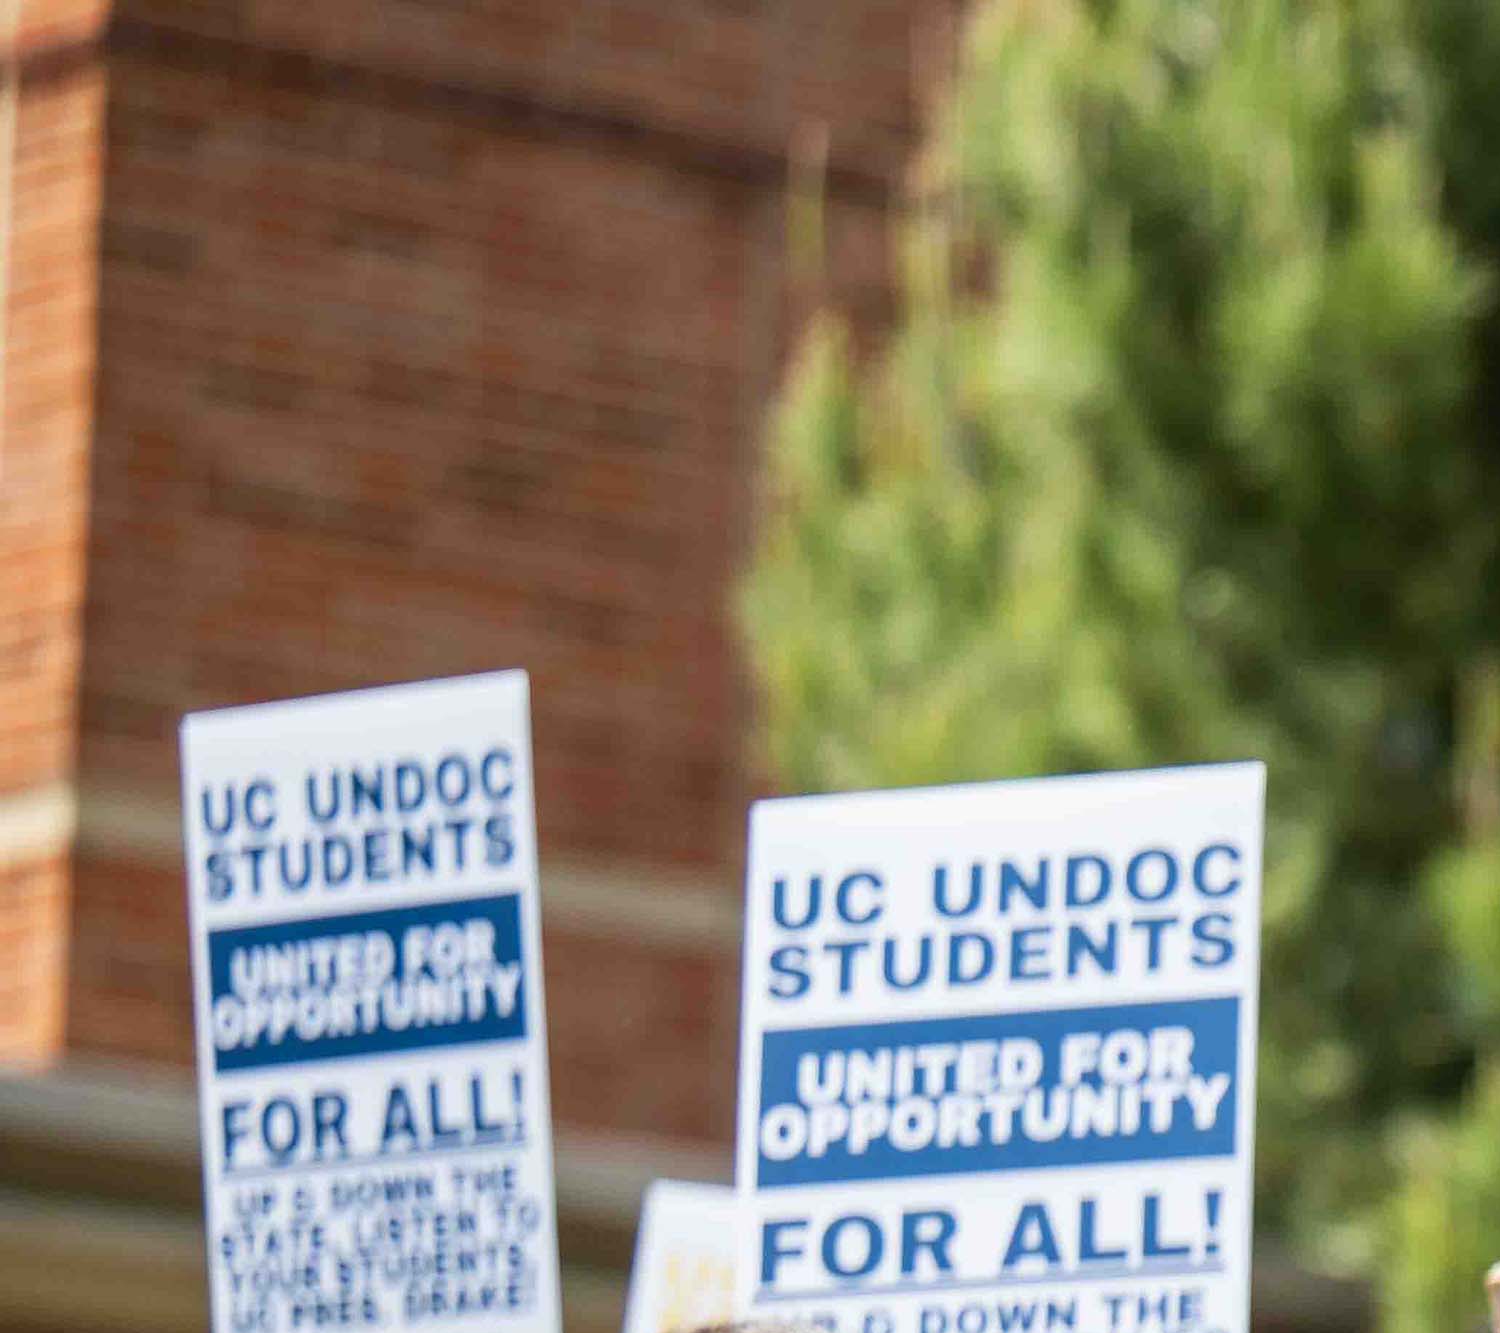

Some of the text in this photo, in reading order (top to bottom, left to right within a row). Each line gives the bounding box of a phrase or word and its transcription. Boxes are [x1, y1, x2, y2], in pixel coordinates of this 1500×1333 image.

[202, 748, 515, 838] UC UNDOC
[205, 813, 515, 904] STUDENTS
[772, 844, 1242, 932] UC UNDOC
[230, 916, 495, 998] UNITED FOR
[767, 912, 1239, 1000] STUDENTS
[213, 960, 522, 1051] OPPORTUNITY
[797, 1025, 1195, 1106] UNITED FOR
[222, 1067, 524, 1160] FOR ALL!
[759, 1072, 1231, 1161] OPPORTUNITY
[760, 1190, 1224, 1285] FOR ALL!
[1103, 1289, 1205, 1327] THE
